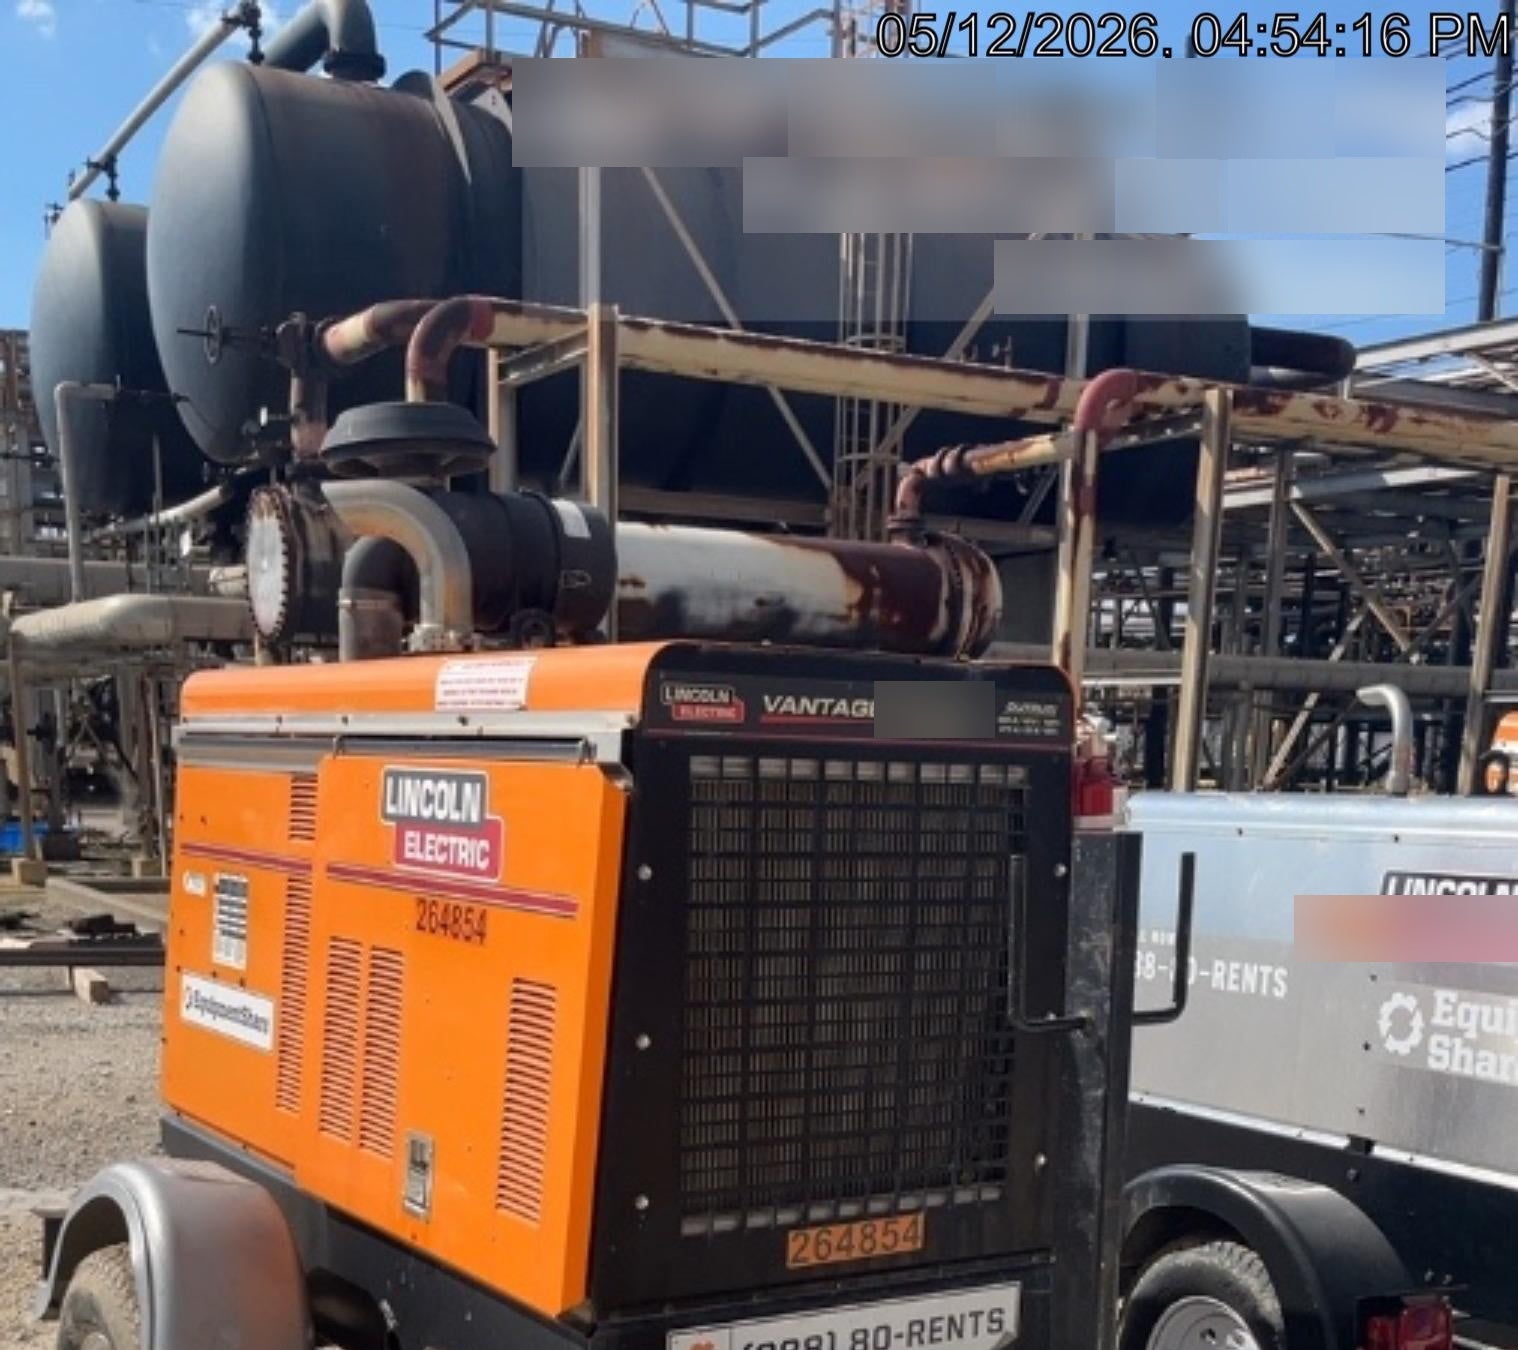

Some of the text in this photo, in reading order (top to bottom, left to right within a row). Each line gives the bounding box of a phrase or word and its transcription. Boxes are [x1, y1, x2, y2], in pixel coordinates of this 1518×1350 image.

[665, 686, 729, 703] LINCOLN
[763, 695, 875, 717] VANTAG
[386, 776, 481, 823] LINCOLN
[404, 831, 490, 869] ELECTRIC
[416, 897, 487, 944] 264854
[790, 1215, 923, 1264] 264854
